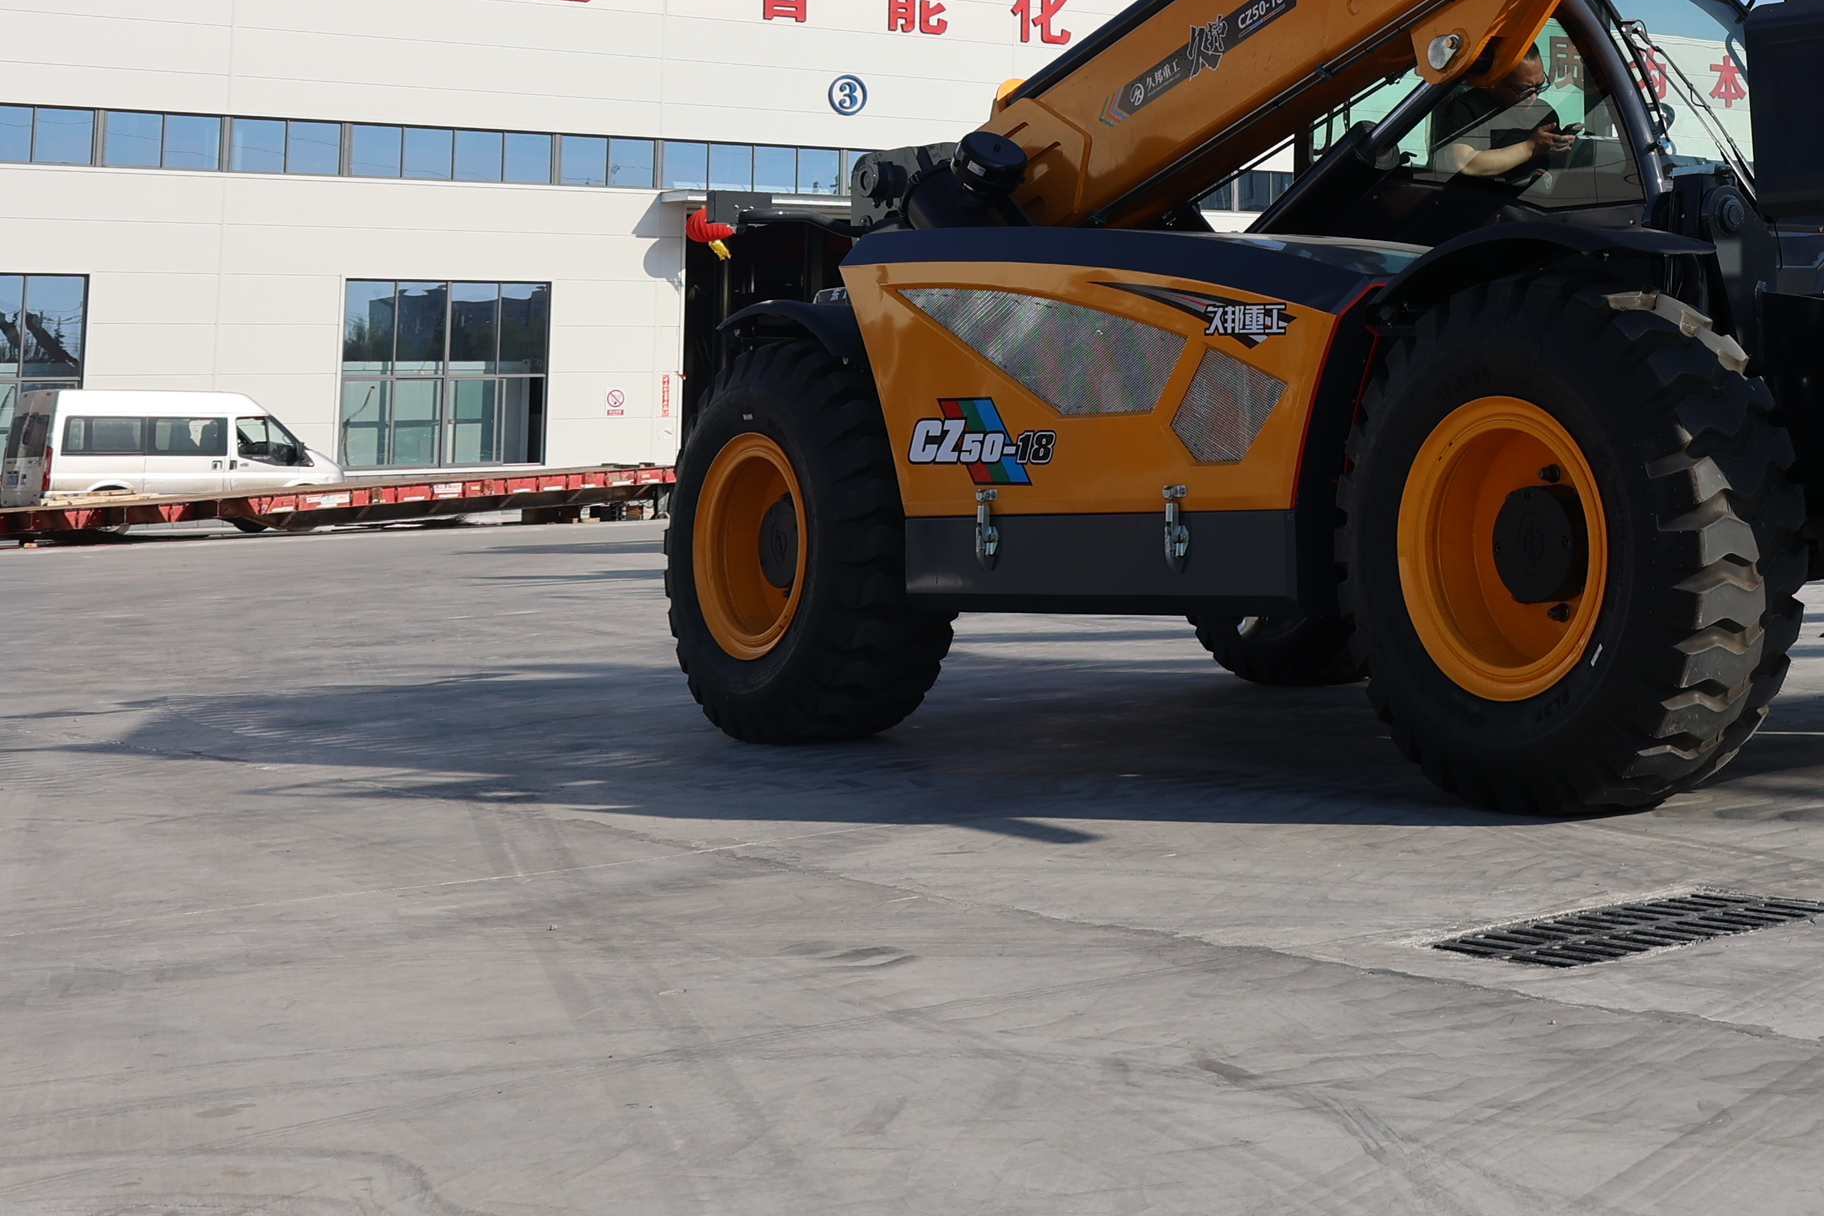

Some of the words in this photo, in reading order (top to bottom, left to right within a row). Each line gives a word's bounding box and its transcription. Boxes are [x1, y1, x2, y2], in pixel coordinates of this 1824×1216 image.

[1145, 58, 1180, 92] 久邦重工
[1205, 303, 1286, 335] 久邦重工
[908, 418, 1056, 464] CZ50-18
